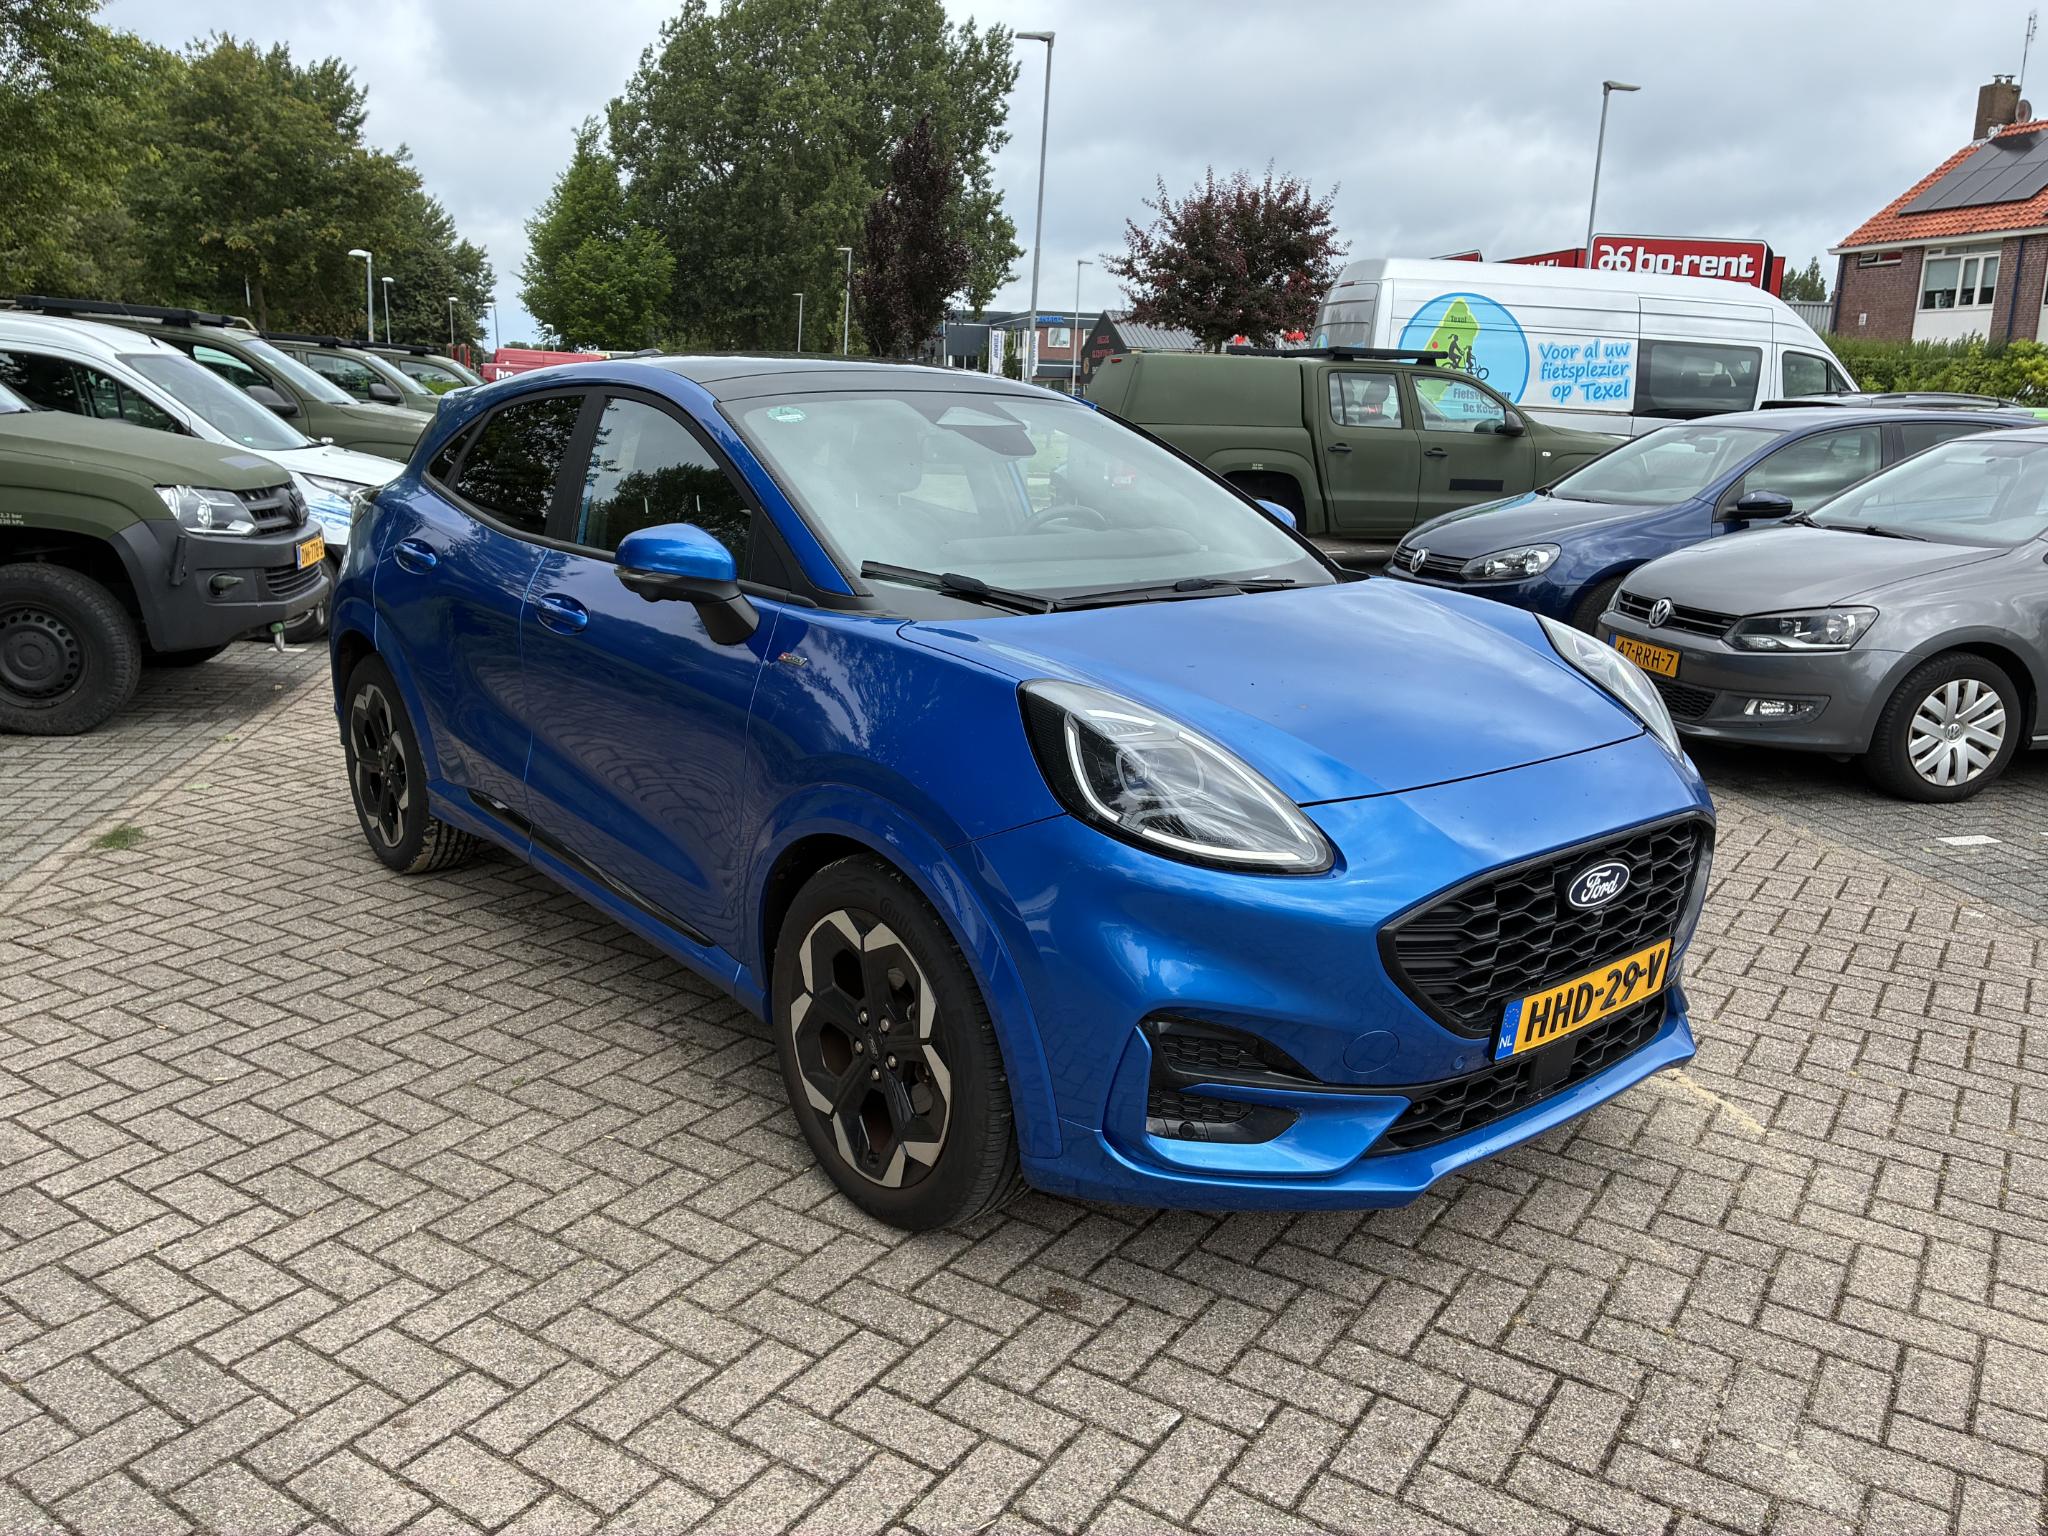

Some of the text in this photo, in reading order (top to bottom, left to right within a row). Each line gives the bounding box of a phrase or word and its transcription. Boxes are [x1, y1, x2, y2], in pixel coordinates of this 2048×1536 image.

[1635, 247, 1755, 278] bo-rent
[1450, 315, 1467, 324] Texel
[1539, 340, 1630, 360] Voor al uw
[1541, 360, 1630, 383] fietsplezier
[1551, 379, 1629, 403] op Texel
[1618, 640, 1675, 672] 47-RRH-7
[1581, 869, 1620, 903] Ford
[1499, 947, 1666, 1049] NL HHD-29-V
